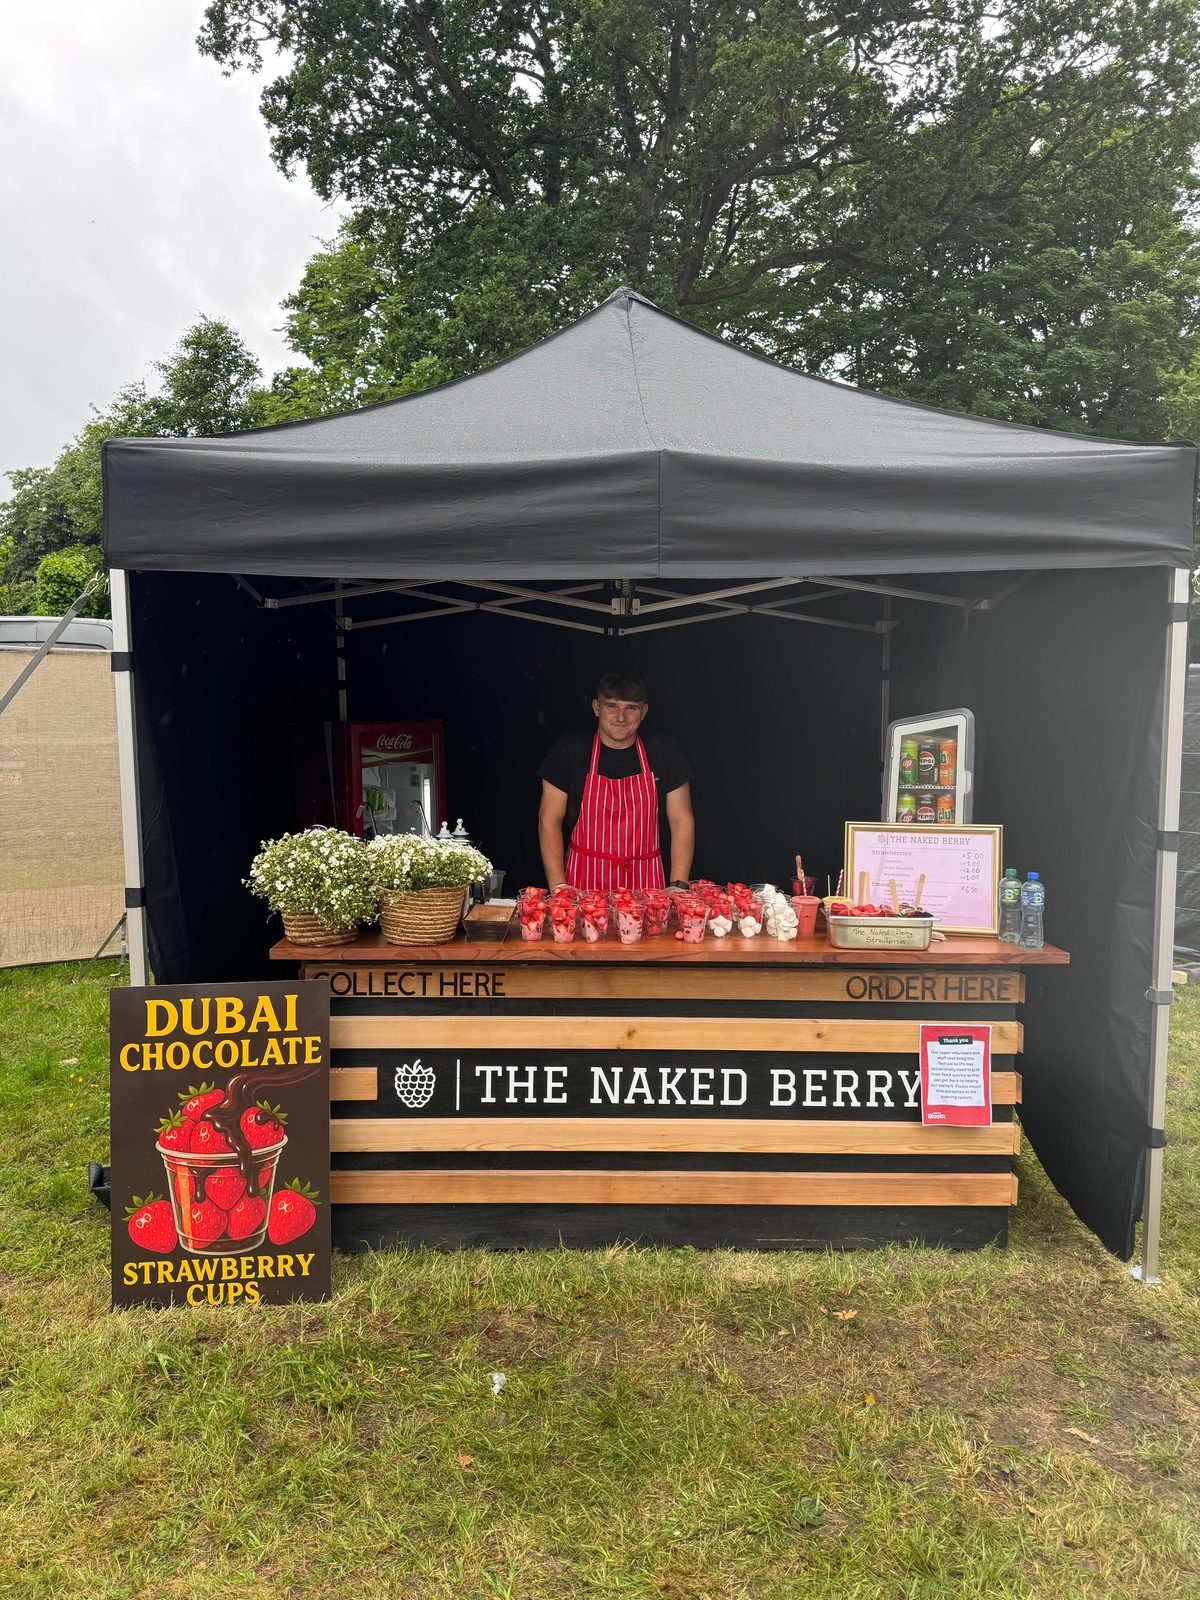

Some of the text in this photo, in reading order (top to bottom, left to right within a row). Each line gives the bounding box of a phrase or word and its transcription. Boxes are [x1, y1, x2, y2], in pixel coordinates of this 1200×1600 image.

[890, 835, 970, 846] THE NAKED BERRY
[870, 928, 889, 936] Naked
[896, 929, 912, 938] Berry
[440, 972, 506, 996] HERE
[846, 976, 1011, 1001] ORDER HERE
[145, 995, 298, 1037] DUBAI
[119, 1036, 322, 1072] CHOCOLATE
[476, 1066, 921, 1108] THE NAKED BERRY
[124, 1254, 314, 1286] STRAWBERRY
[186, 1281, 260, 1307] CUPS
